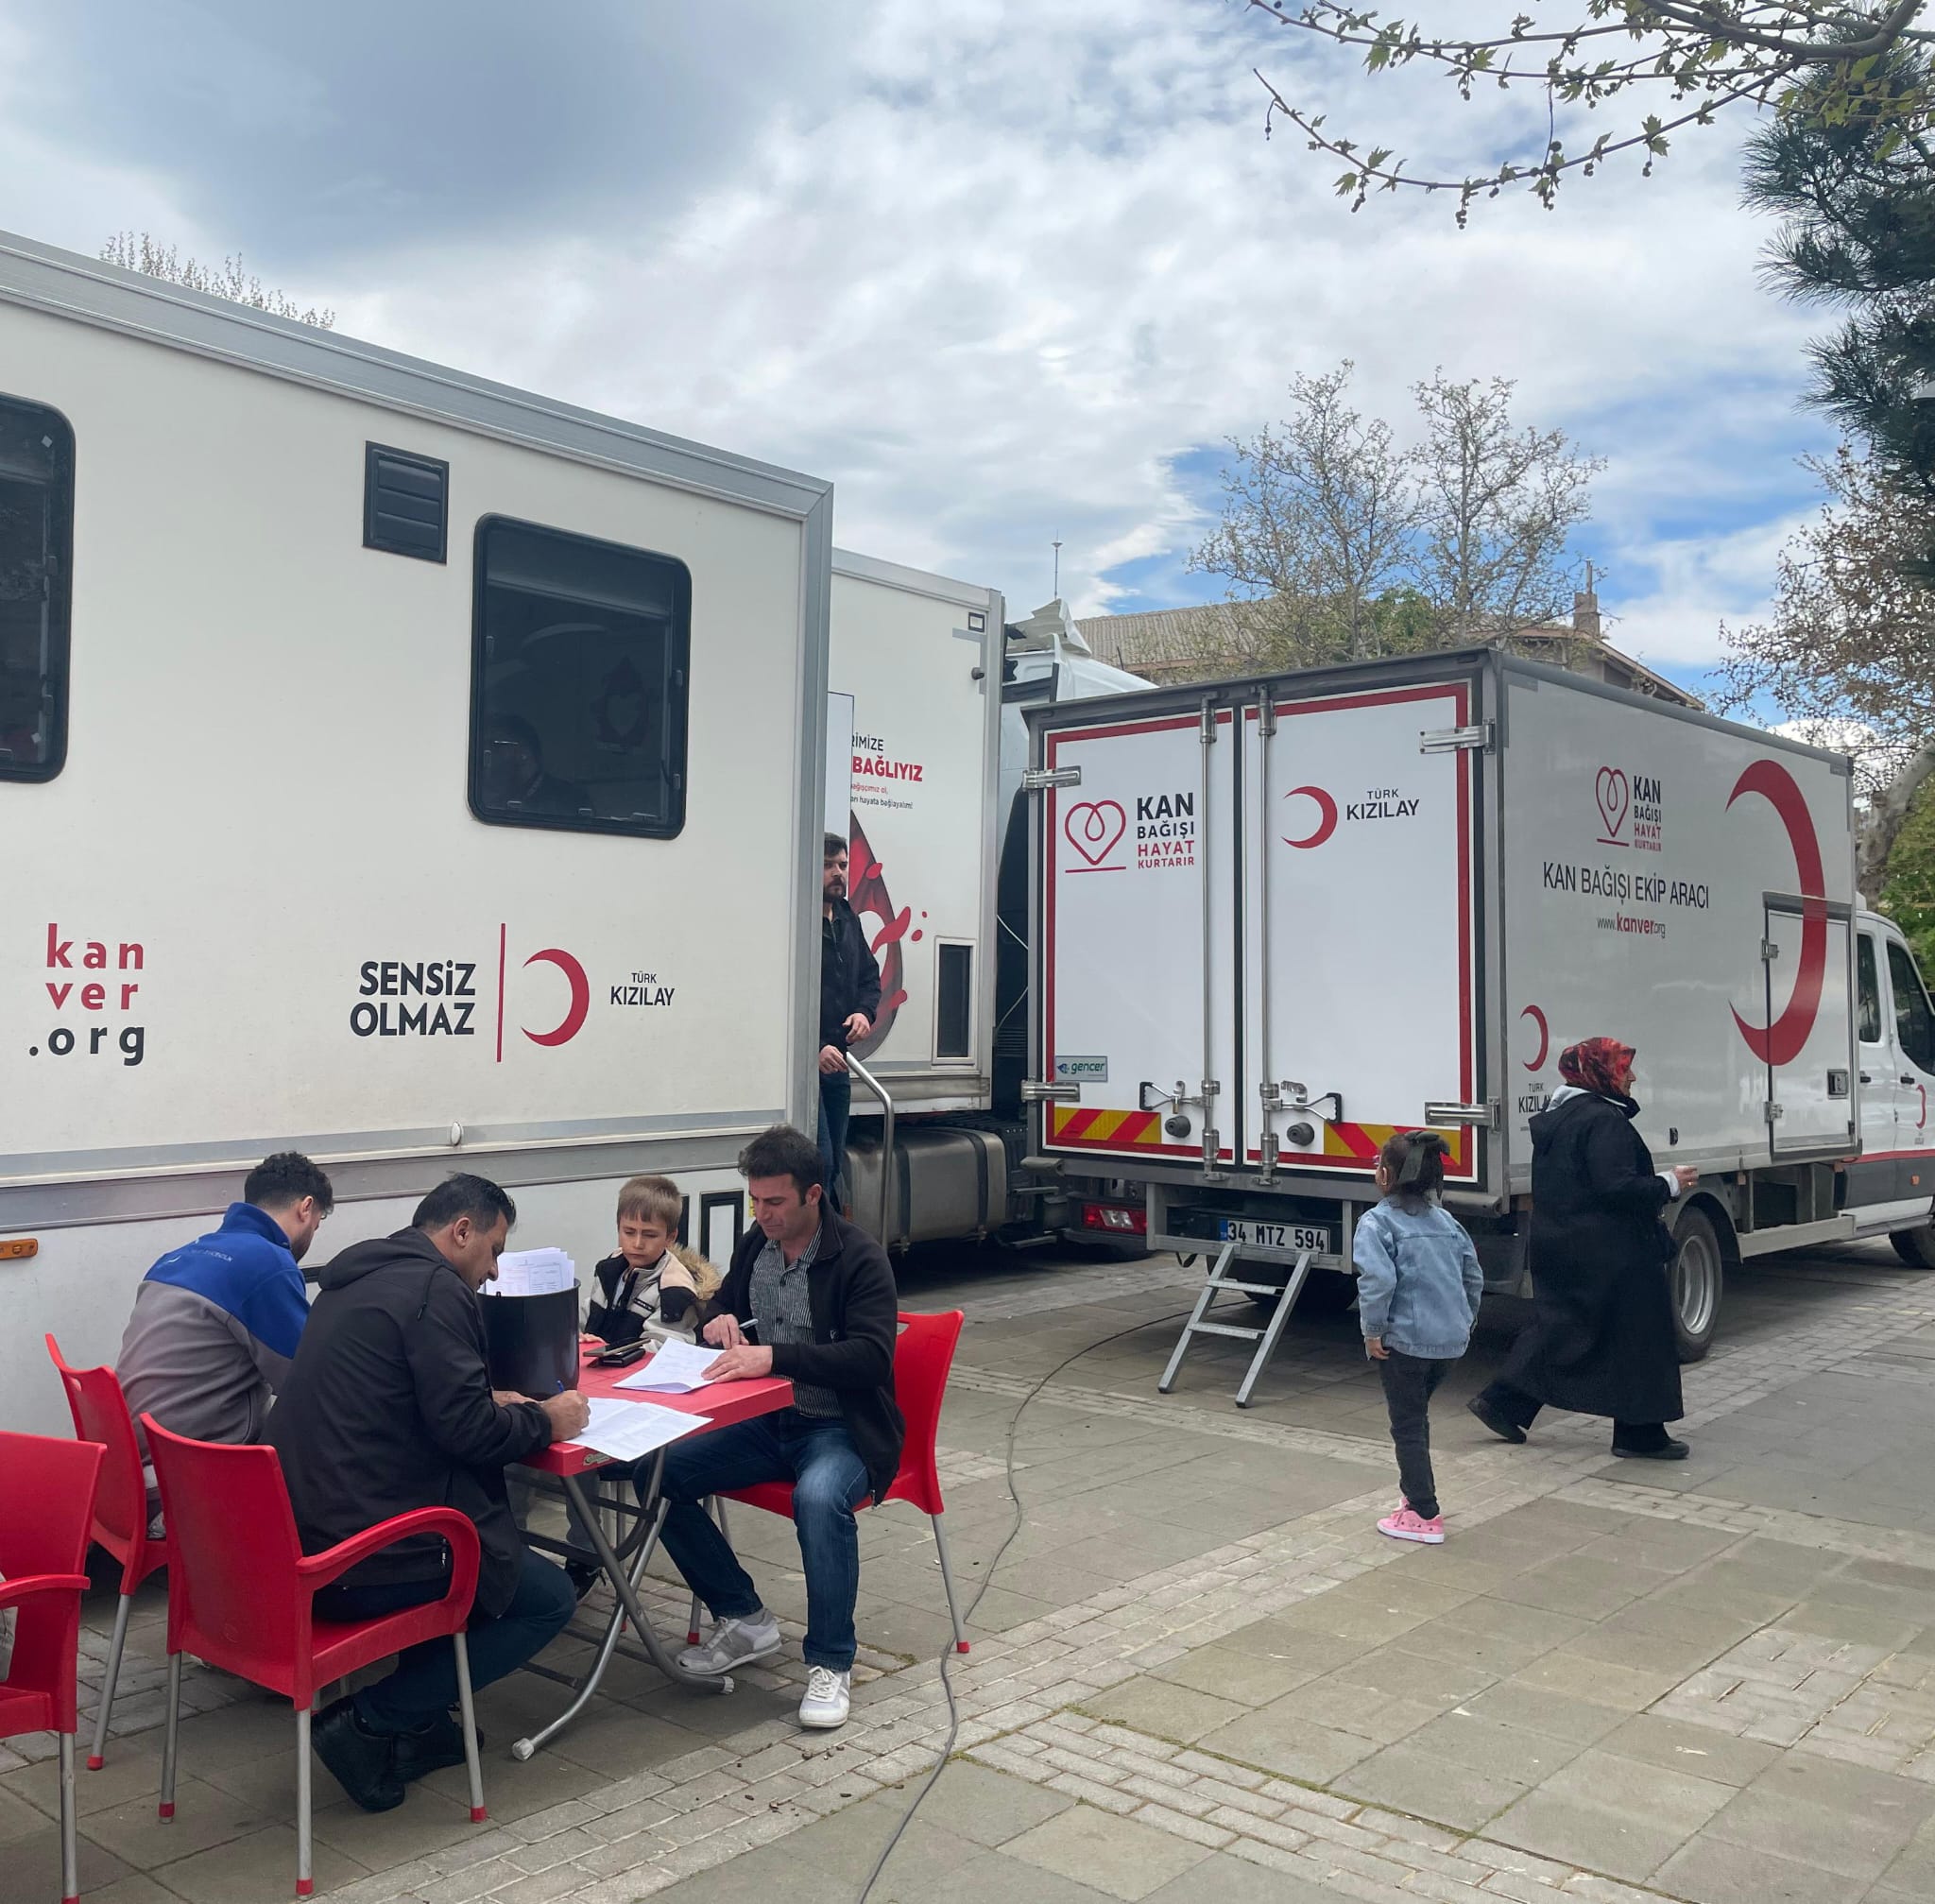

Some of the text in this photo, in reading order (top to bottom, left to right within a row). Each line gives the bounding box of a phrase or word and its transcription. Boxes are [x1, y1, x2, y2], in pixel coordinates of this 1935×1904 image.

[852, 755, 922, 781] BAĞLIYIZ
[1366, 788, 1399, 799] TÜRK
[1634, 776, 1660, 804] KAN
[1137, 792, 1193, 820] KAN
[1346, 798, 1419, 820] KIZILAY
[1634, 804, 1661, 825] BAĞIŞI
[1137, 819, 1194, 841] BAĞIŞI
[1634, 822, 1661, 839] HAYAT
[1138, 840, 1194, 857] HAYAT
[1138, 856, 1194, 869] KURTARIR
[1543, 861, 1709, 909] KAN BAĞIŞI EKİP ARACI
[46, 923, 144, 969] kan
[630, 970, 658, 984] TÜRK
[45, 982, 139, 1011] ver
[610, 986, 676, 1006] KIZILAY
[350, 1002, 475, 1038] OLMAZ
[28, 1026, 145, 1067] .org
[1070, 1062, 1104, 1075] gencer
[1228, 1223, 1325, 1250] 34 MTZ 594
